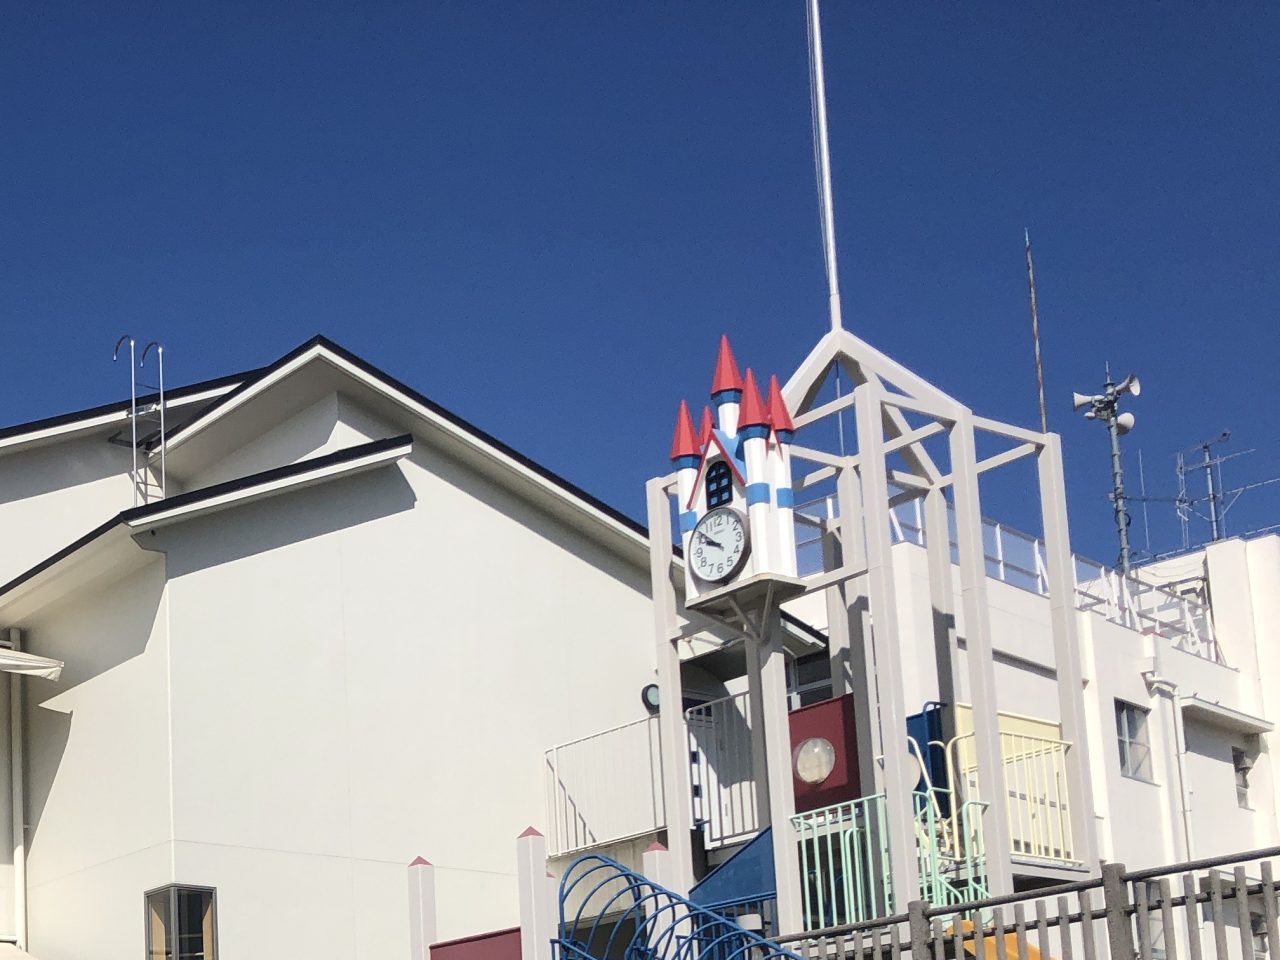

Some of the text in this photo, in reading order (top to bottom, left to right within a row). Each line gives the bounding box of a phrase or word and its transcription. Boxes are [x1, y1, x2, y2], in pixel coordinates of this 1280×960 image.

[732, 520, 740, 531] 2
[735, 531, 742, 543] 3
[696, 547, 703, 558] 9
[733, 544, 740, 554] 4
[700, 557, 707, 568] 8
[726, 556, 733, 567] 5
[708, 563, 715, 574] 7
[716, 562, 724, 574] 6
